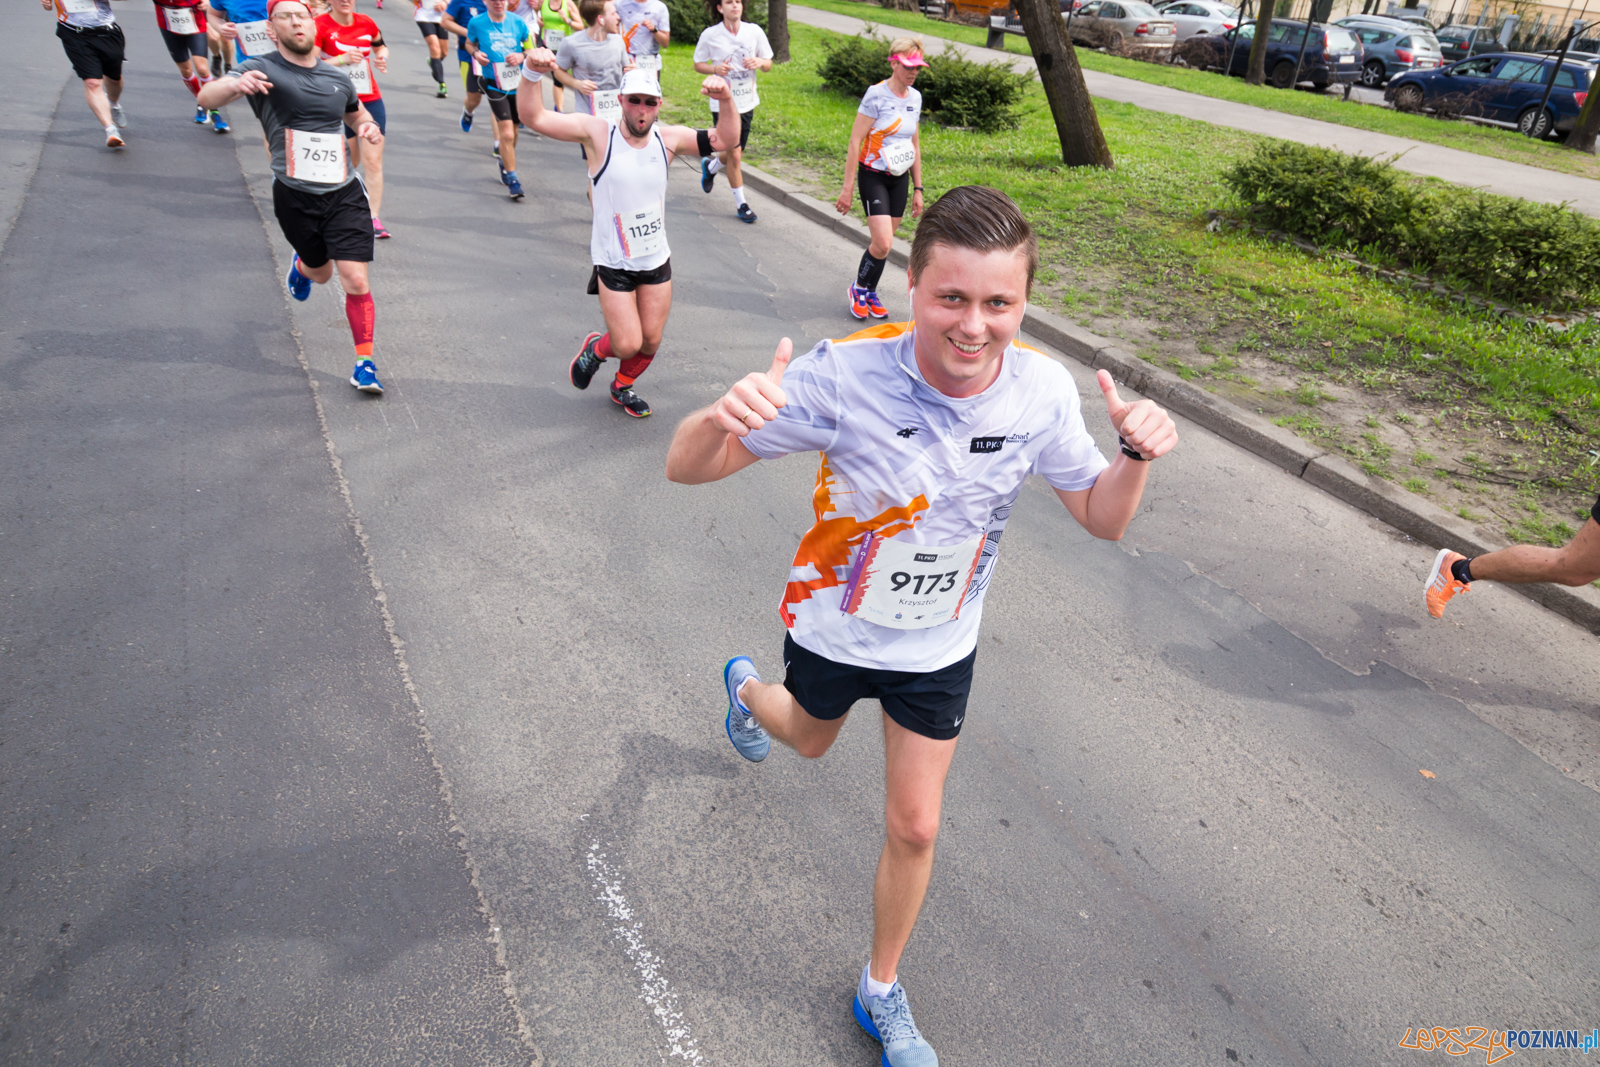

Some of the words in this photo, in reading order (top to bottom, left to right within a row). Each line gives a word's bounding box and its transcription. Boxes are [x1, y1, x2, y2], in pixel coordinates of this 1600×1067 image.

[170, 16, 190, 24] 2955
[245, 32, 268, 42] 6312
[598, 99, 619, 109] 8034
[302, 147, 338, 162] 7675
[890, 151, 914, 165] 10082
[629, 218, 661, 238] 11253
[896, 427, 919, 439] 4F
[986, 441, 1002, 449] PKO
[890, 570, 959, 595] 9173
[899, 598, 938, 607] Krzysztof
